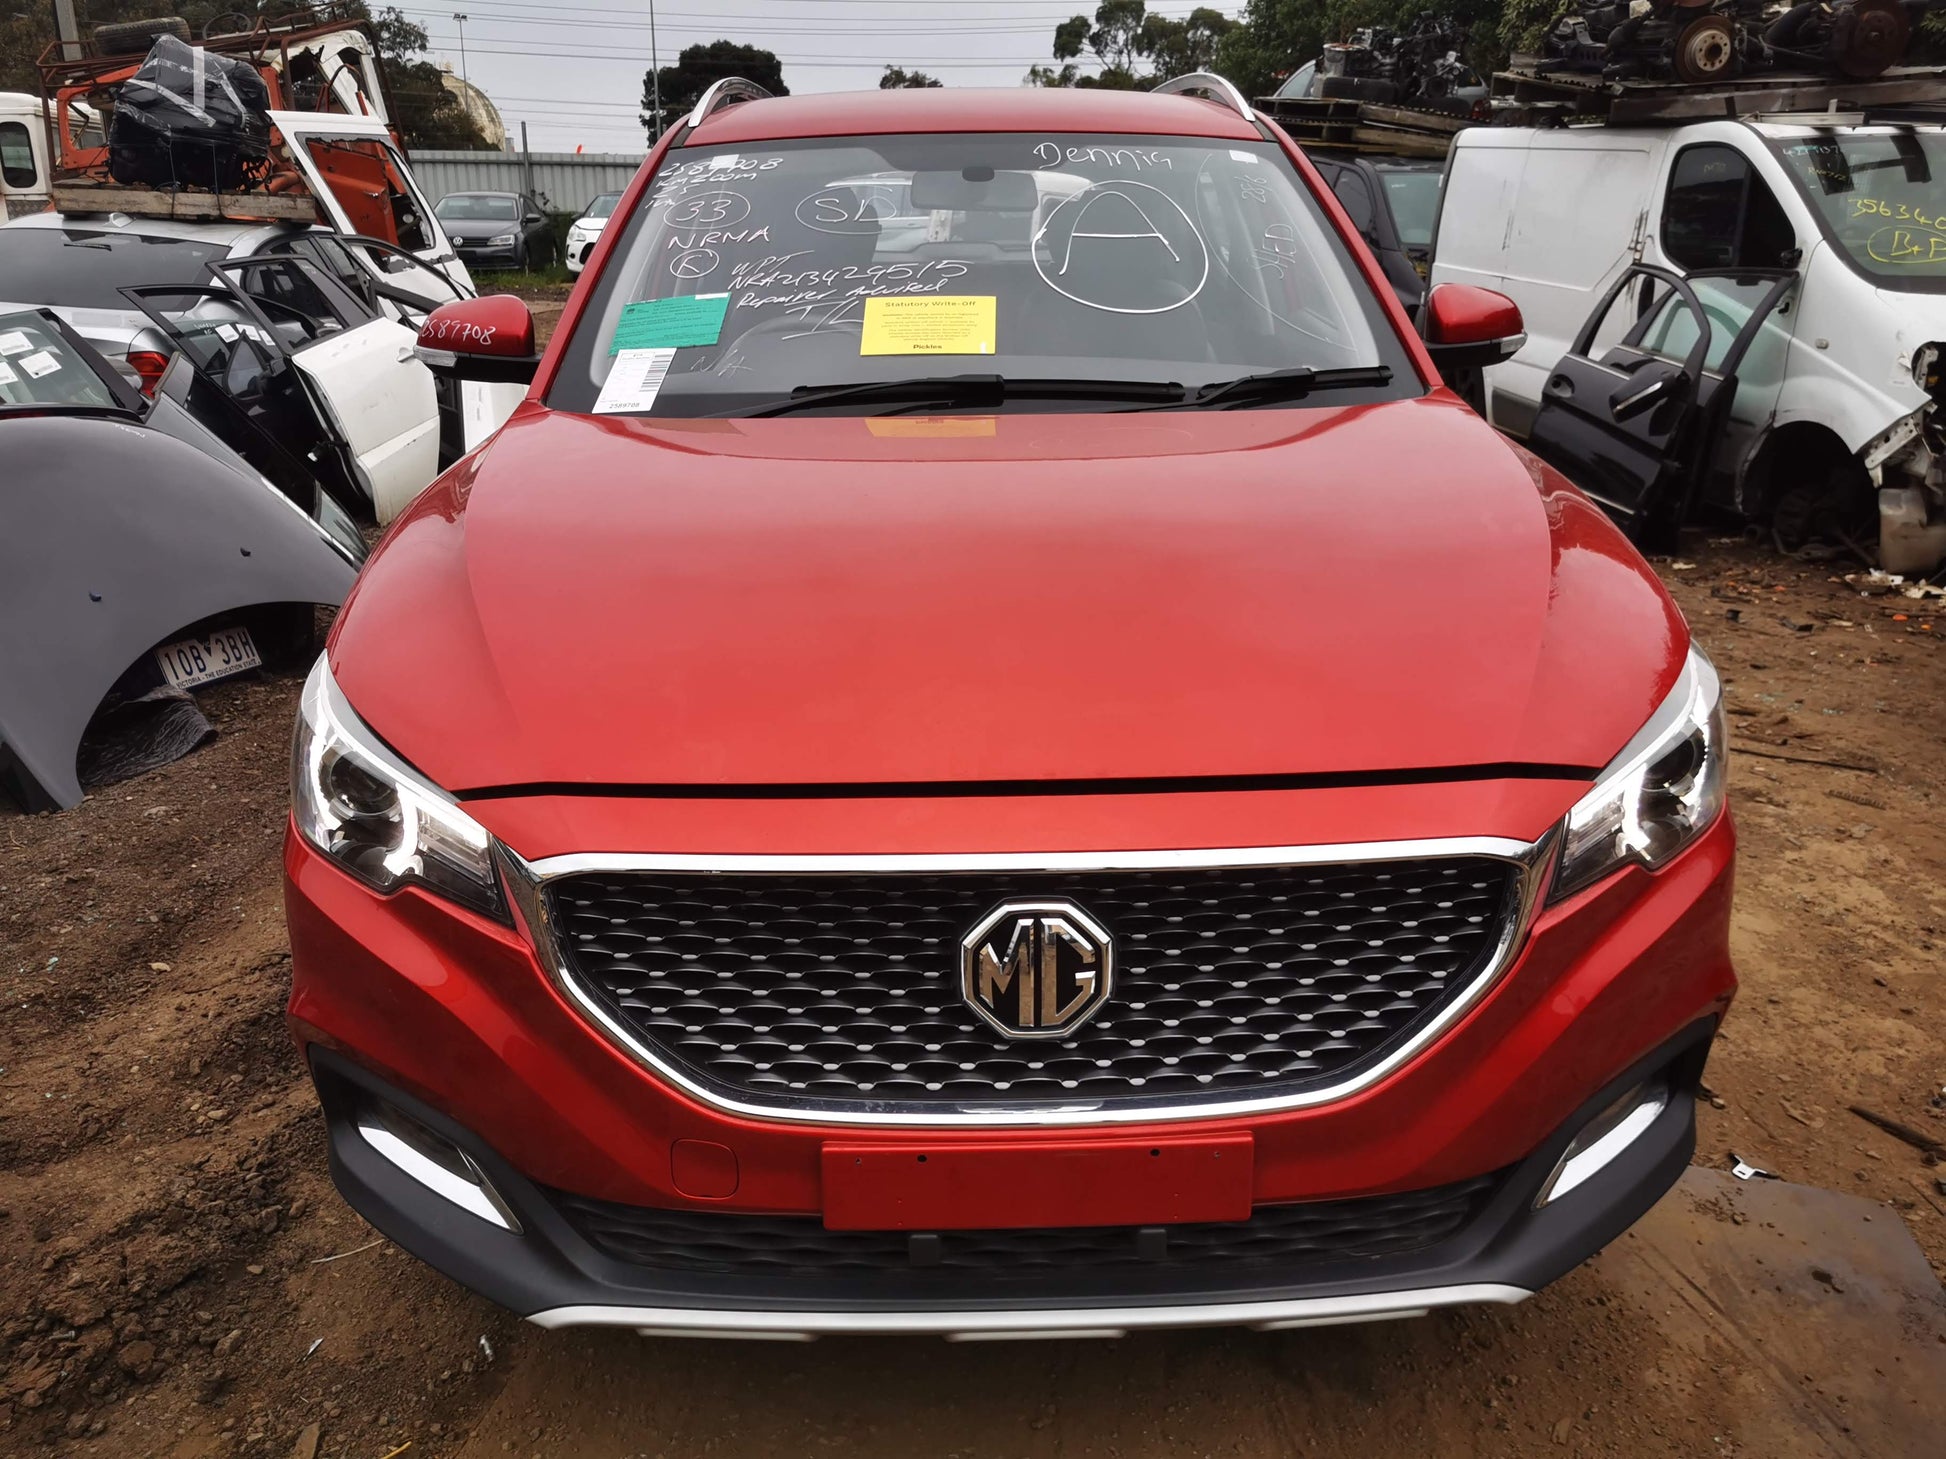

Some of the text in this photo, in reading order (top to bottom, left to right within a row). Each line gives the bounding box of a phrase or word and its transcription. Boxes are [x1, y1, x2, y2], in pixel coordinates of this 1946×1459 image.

[667, 226, 770, 250] NRMA
[1058, 191, 1181, 276] A
[175, 676, 202, 689] VICTORIA
[215, 663, 243, 677] EDUCATION
[243, 658, 258, 668] STATE
[979, 918, 1096, 1027] MG
